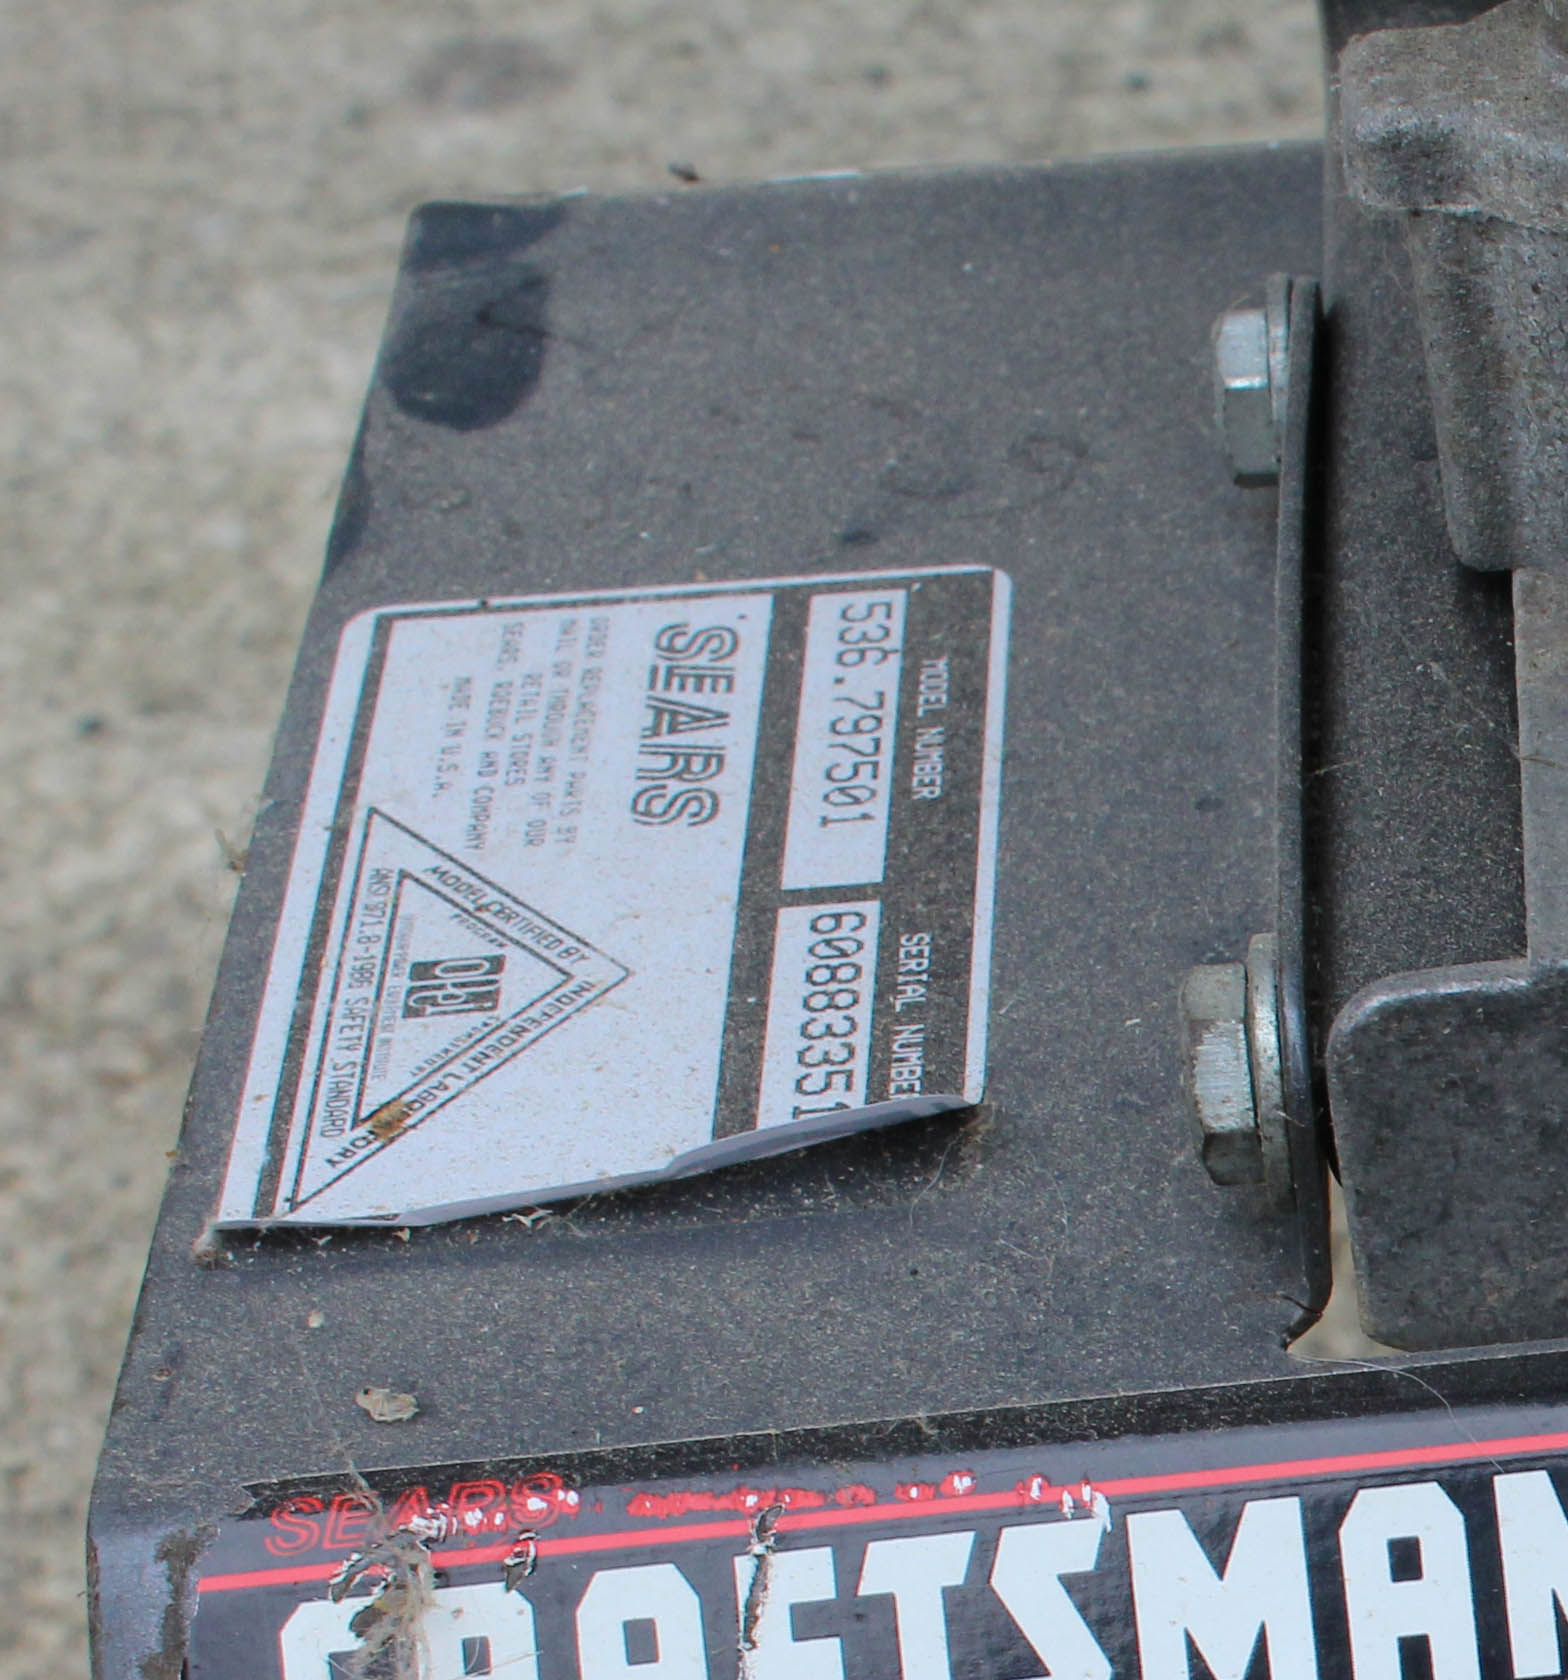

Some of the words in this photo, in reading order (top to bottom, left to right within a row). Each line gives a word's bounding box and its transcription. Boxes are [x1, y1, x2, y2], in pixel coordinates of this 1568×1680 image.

[820, 601, 892, 829] 536.797501
[917, 657, 948, 717] MODEL
[630, 624, 742, 828] SEARS
[911, 727, 944, 799] NUMBER
[465, 786, 495, 851] COMPANY
[523, 819, 547, 847] OUR
[369, 868, 393, 896] ANSI
[423, 865, 485, 908] MODEL
[474, 900, 564, 951] CERTIFIED
[557, 944, 591, 965] BY
[895, 932, 931, 1013] SERIAL
[338, 998, 369, 1052] SAFETY
[461, 980, 596, 1075] INDEPENDENT
[793, 911, 867, 1121] 60883351
[320, 1061, 358, 1138] STANDARD
[889, 1024, 925, 1101] NUMBE
